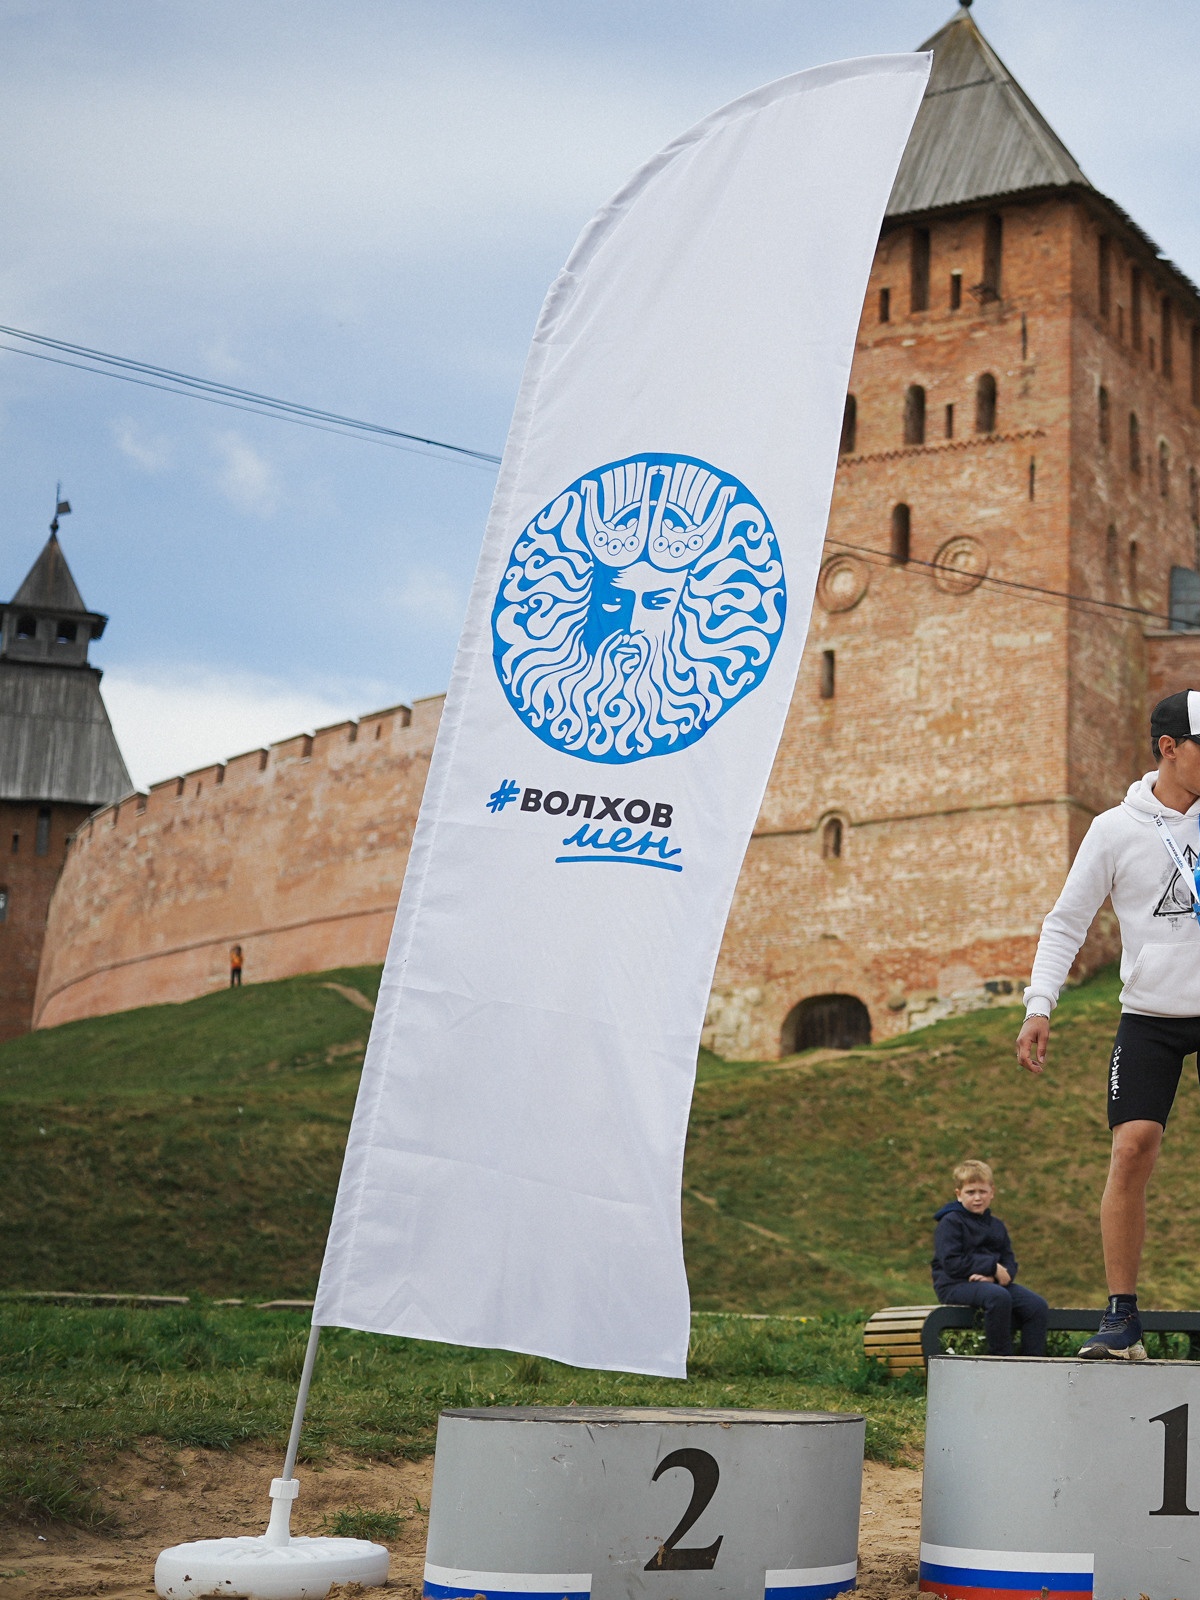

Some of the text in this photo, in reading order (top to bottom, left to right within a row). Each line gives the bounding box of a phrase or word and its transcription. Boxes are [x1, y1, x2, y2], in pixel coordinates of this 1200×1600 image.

[486, 779, 674, 829] #ВОЛХОВ
[643, 1447, 724, 1572] 2
[1148, 1403, 1200, 1516] 1
